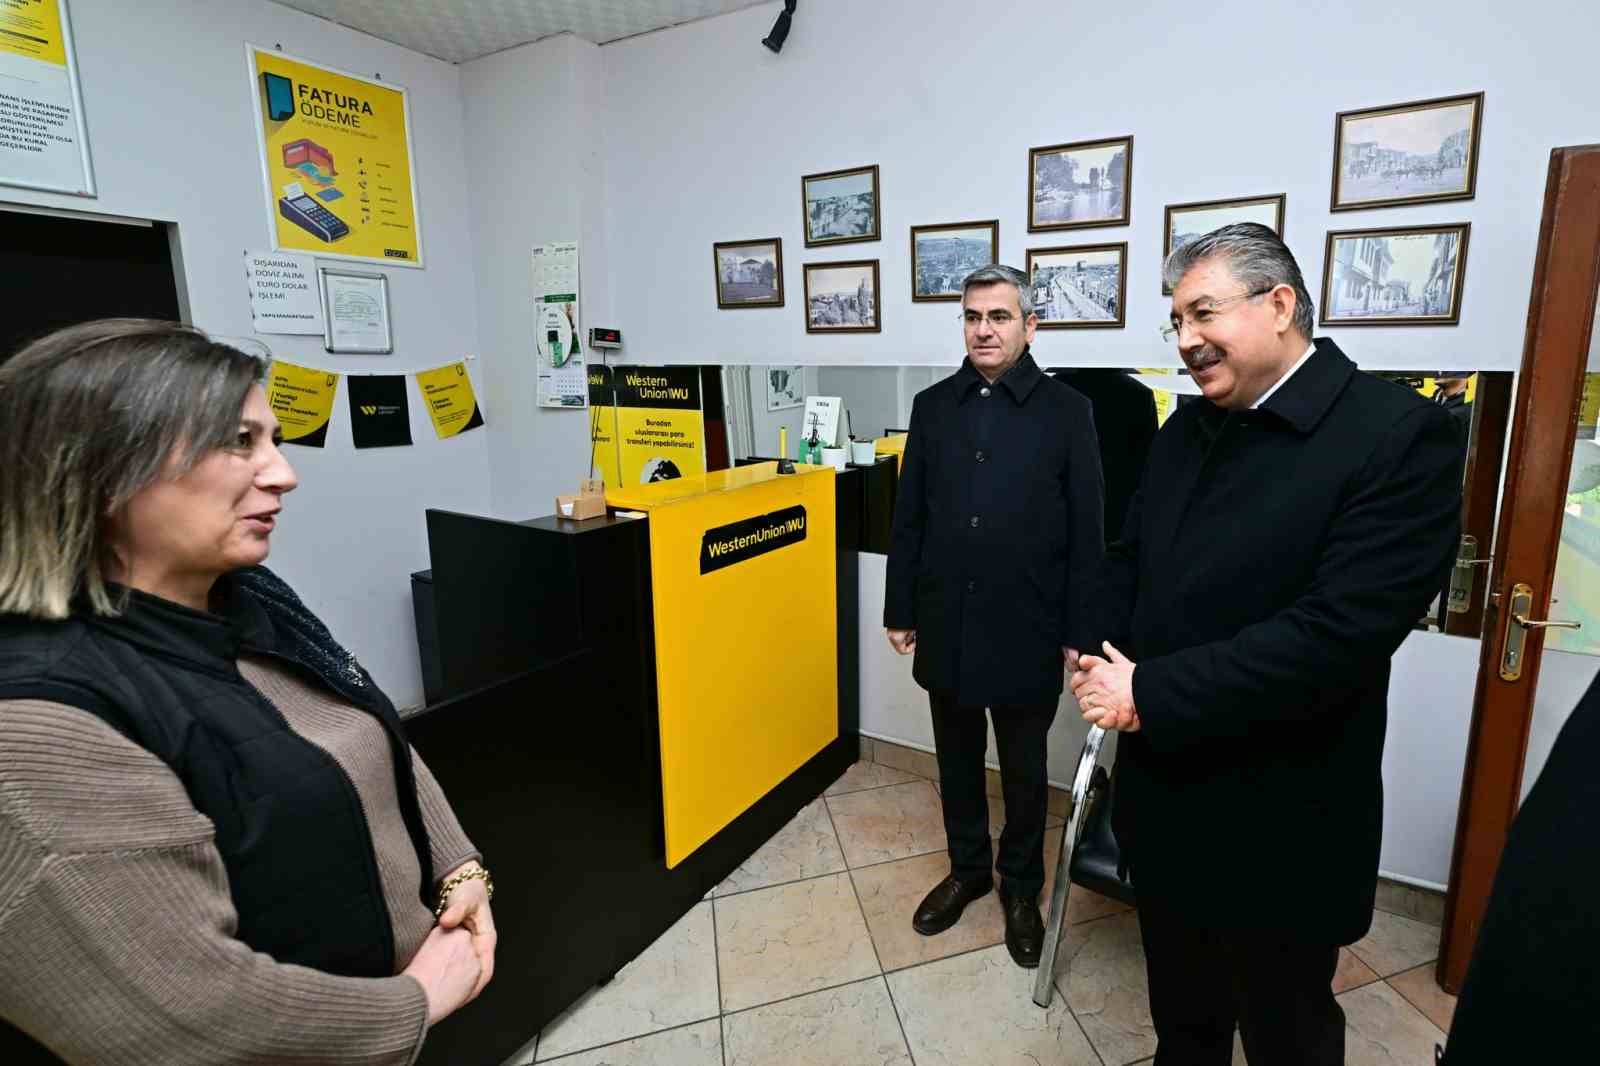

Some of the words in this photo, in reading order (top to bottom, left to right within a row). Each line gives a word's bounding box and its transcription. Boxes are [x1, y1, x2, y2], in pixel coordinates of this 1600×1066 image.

[298, 84, 373, 115] FATURA
[301, 98, 361, 128] ÖDEME
[625, 375, 668, 387] Western
[640, 386, 668, 399] Union
